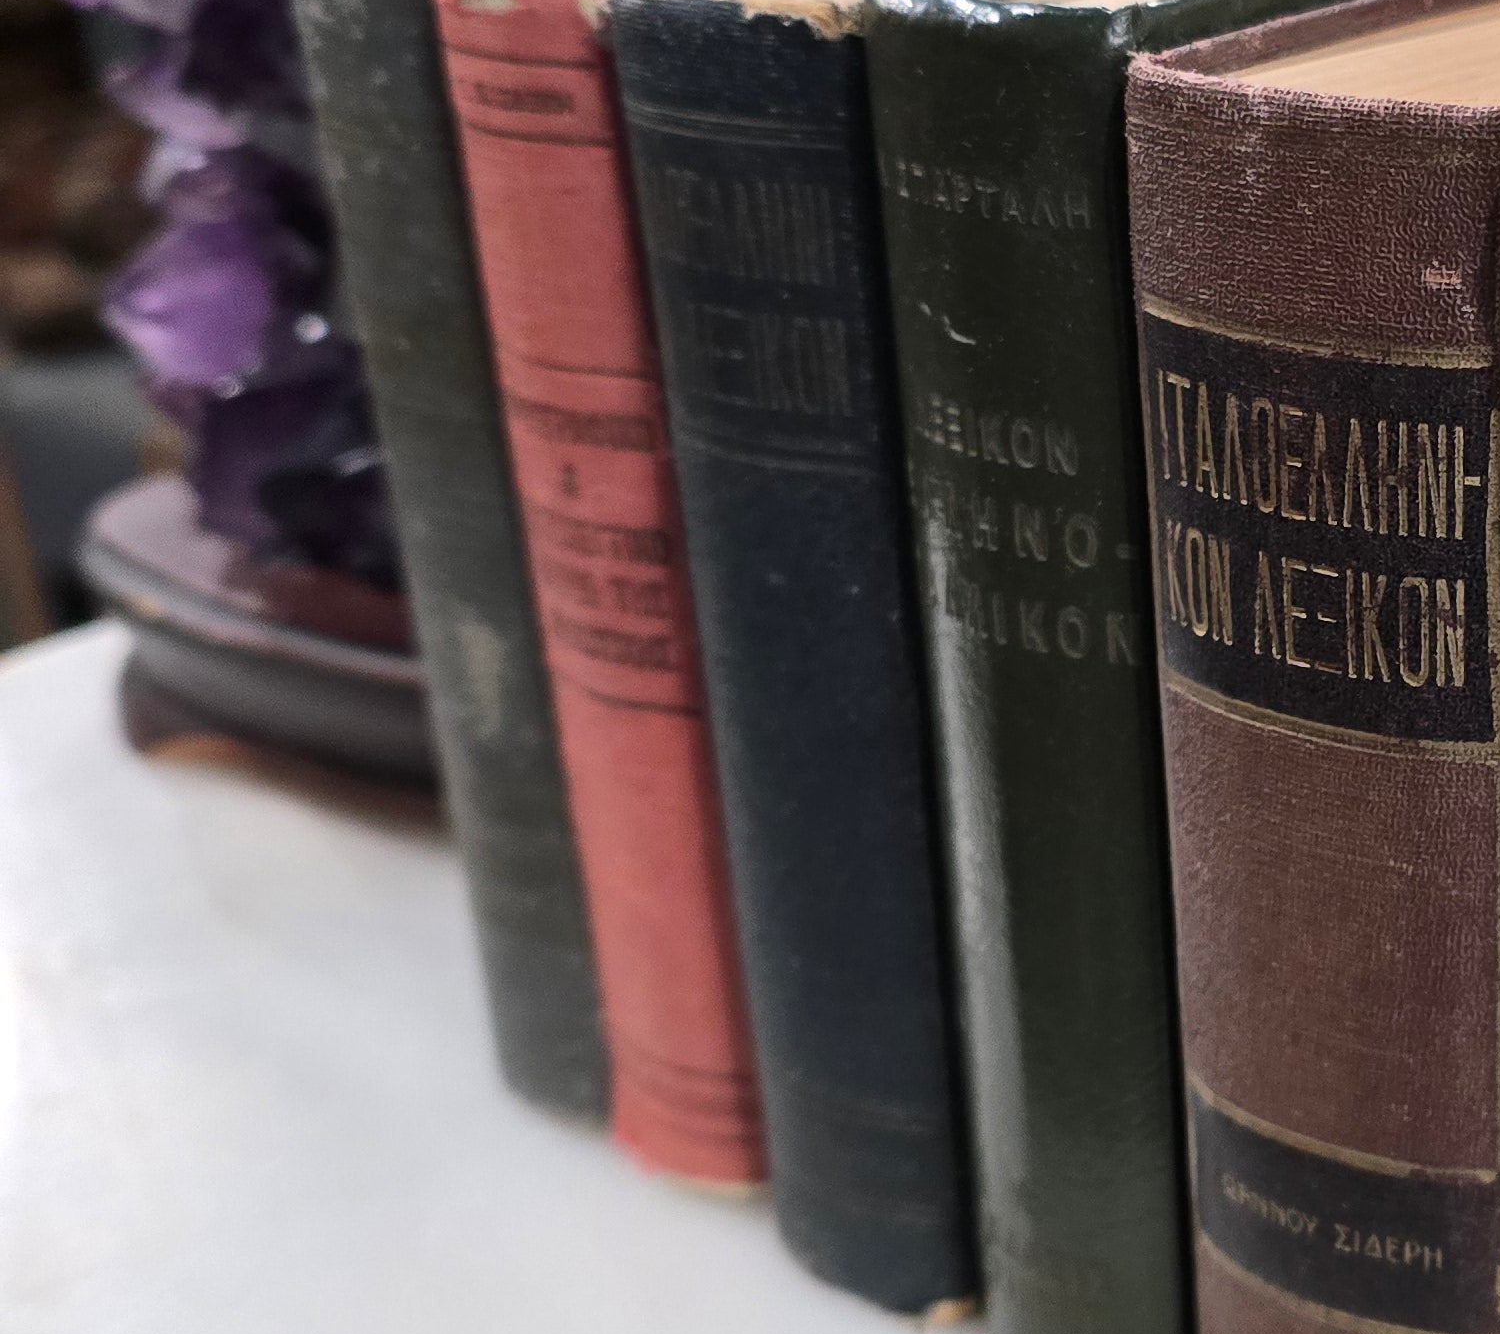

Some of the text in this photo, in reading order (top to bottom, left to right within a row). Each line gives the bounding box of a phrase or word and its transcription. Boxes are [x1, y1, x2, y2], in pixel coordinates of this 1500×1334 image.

[1157, 369, 1482, 541] ΙΤΑΛΟΕΛΛΗΝΙ-
[1165, 518, 1467, 690] ΚΟΝ ΛΕΞΙΚΟΝ
[1332, 1220, 1445, 1276] ΣΙΔΕΡΗ
